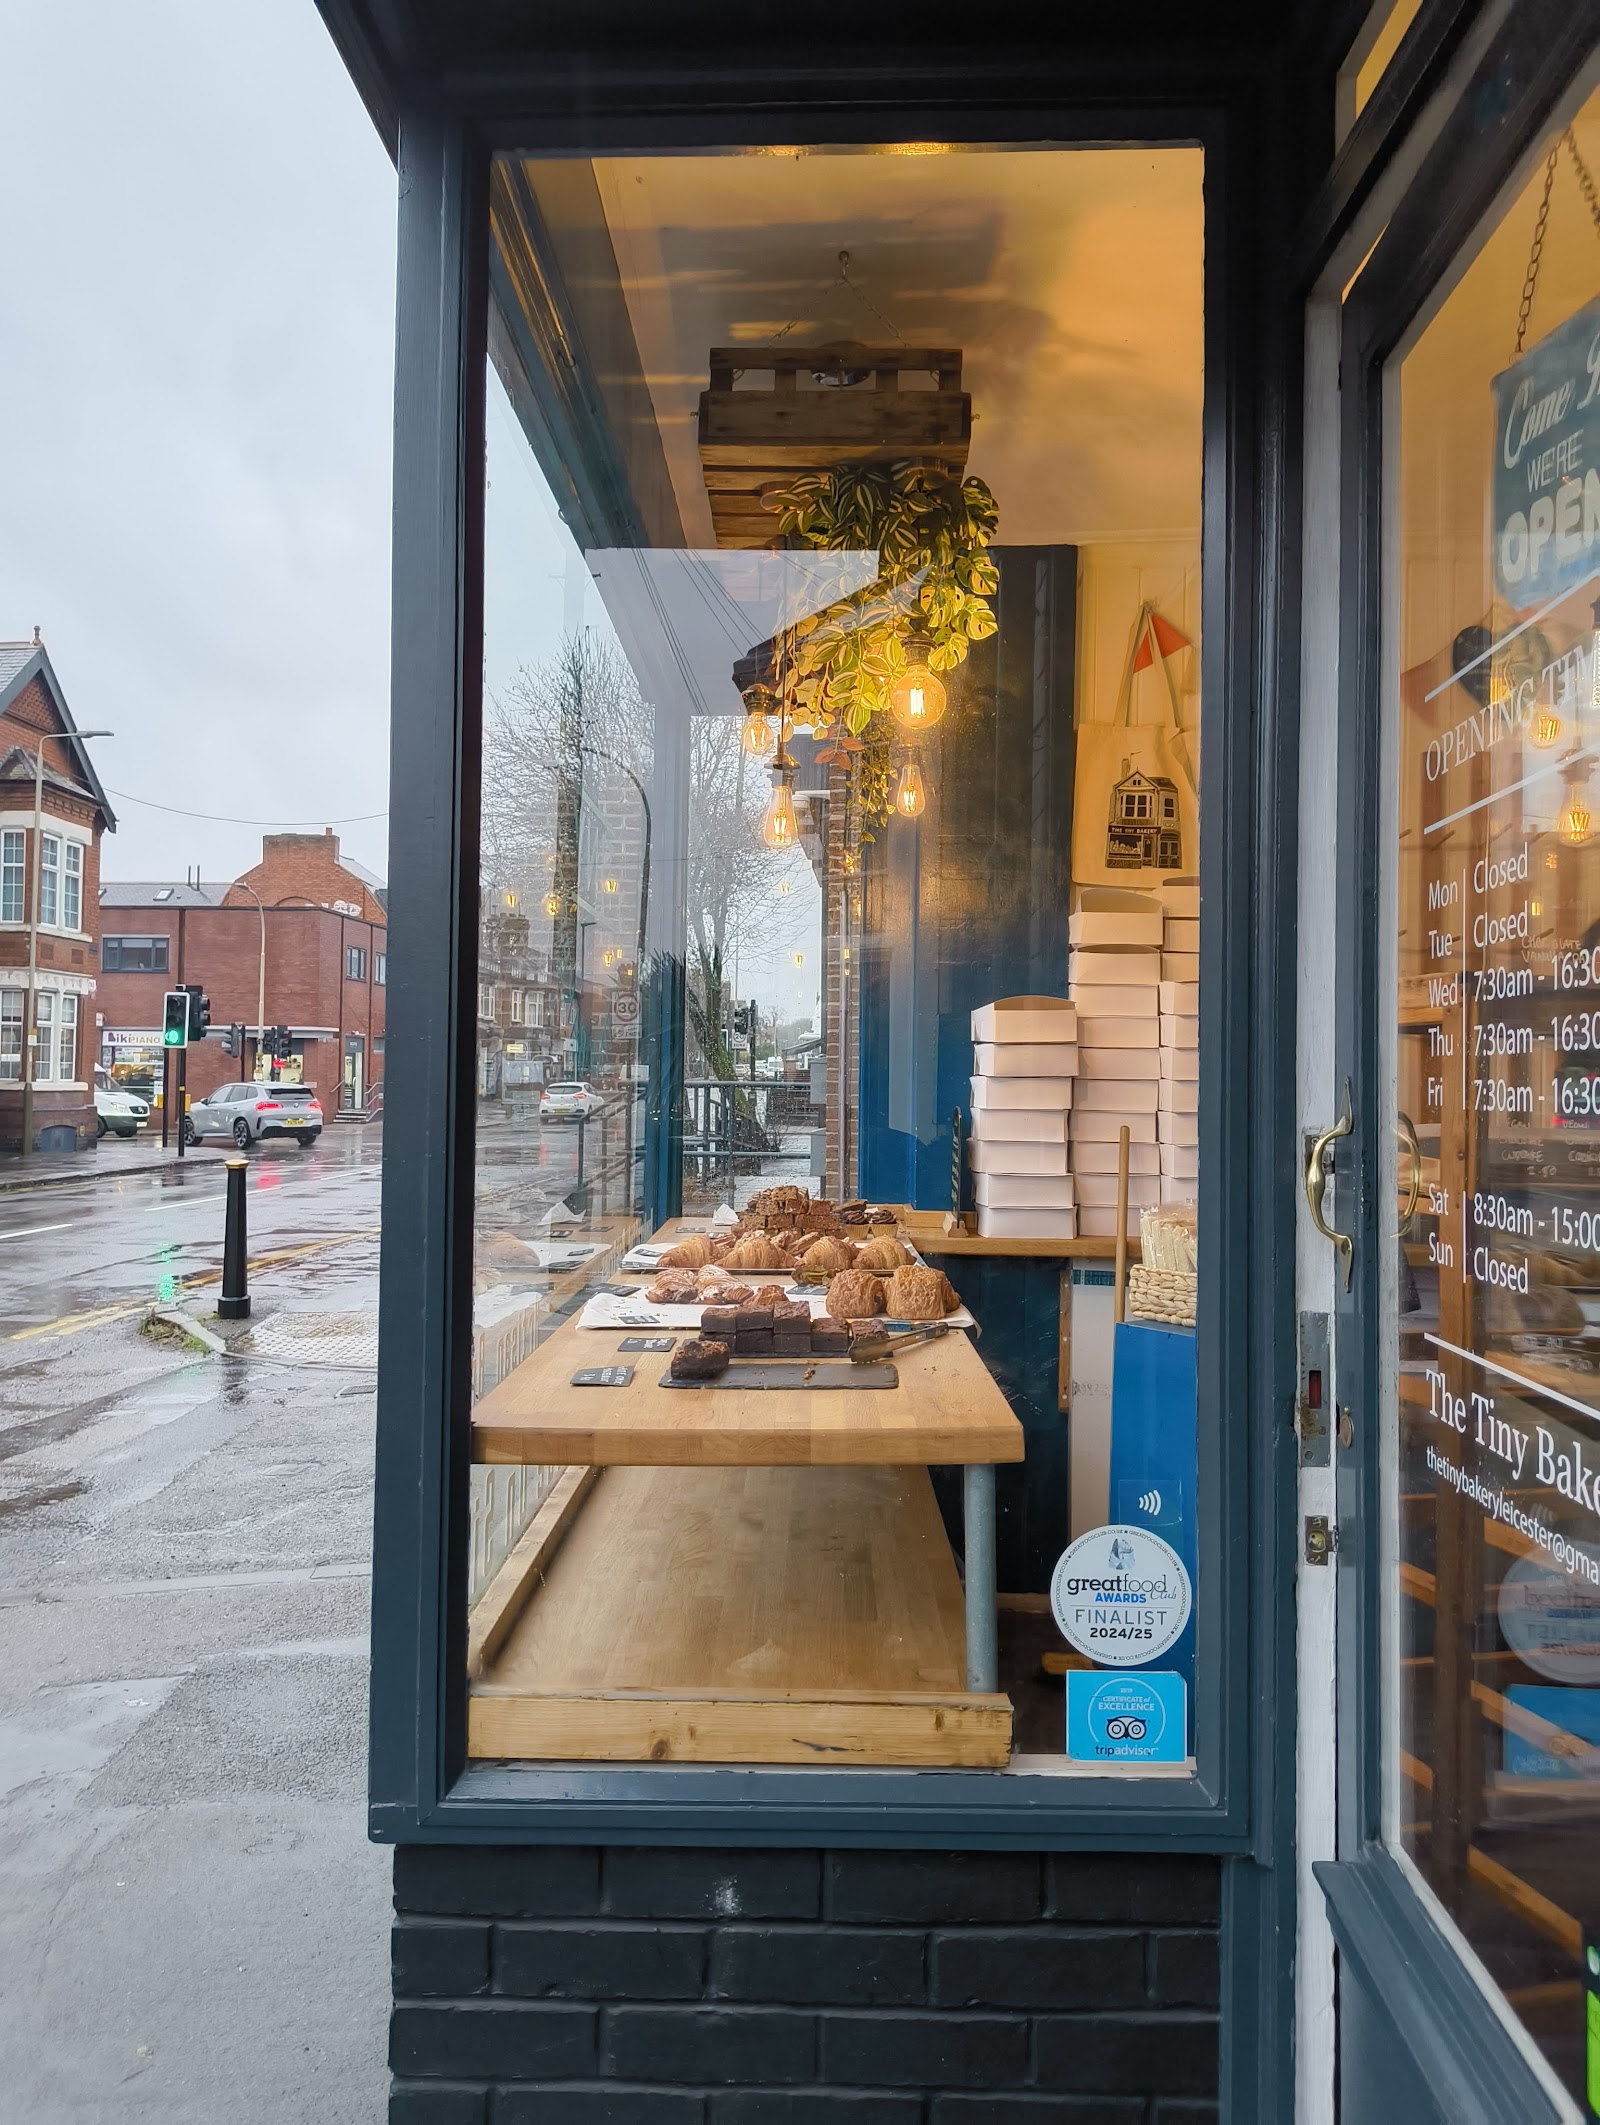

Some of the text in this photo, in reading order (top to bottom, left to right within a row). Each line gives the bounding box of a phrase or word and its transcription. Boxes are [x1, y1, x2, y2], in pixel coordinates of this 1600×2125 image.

[1503, 375, 1574, 469] Come
[1527, 430, 1584, 493] WE'RE
[1426, 677, 1535, 782] OPENING
[1428, 842, 1528, 912] Mon Closed
[1428, 900, 1528, 959] Tue Closed
[1428, 973, 1458, 1008] Wed
[1473, 966, 1533, 1002] 7:30am
[1551, 945, 1600, 991] 16:30
[618, 1002, 637, 1013] 30
[1428, 1028, 1454, 1057] Thu
[1473, 1022, 1533, 1056] 7:30am
[1551, 1011, 1600, 1052] 16:30
[1428, 1077, 1443, 1107] Fri
[1473, 1079, 1533, 1113] 7:30am
[1551, 1076, 1600, 1115] 16:30
[1428, 1183, 1449, 1216] Sat
[1473, 1192, 1533, 1236] 8:30am
[1551, 1206, 1600, 1251] 15:00
[1428, 1231, 1528, 1295] Sun Closed
[1426, 1368, 1467, 1433] The
[1471, 1391, 1529, 1481] Tiny
[1075, 1609, 1167, 1625] FINALIST
[1095, 1592, 1147, 1603] AWARDS
[1089, 1627, 1153, 1640] 2024/25
[1098, 1702, 1155, 1711] EXCELLENCE
[1102, 1695, 1143, 1703] CERTIFICATE
[1094, 1744, 1155, 1757] tripadvisor
